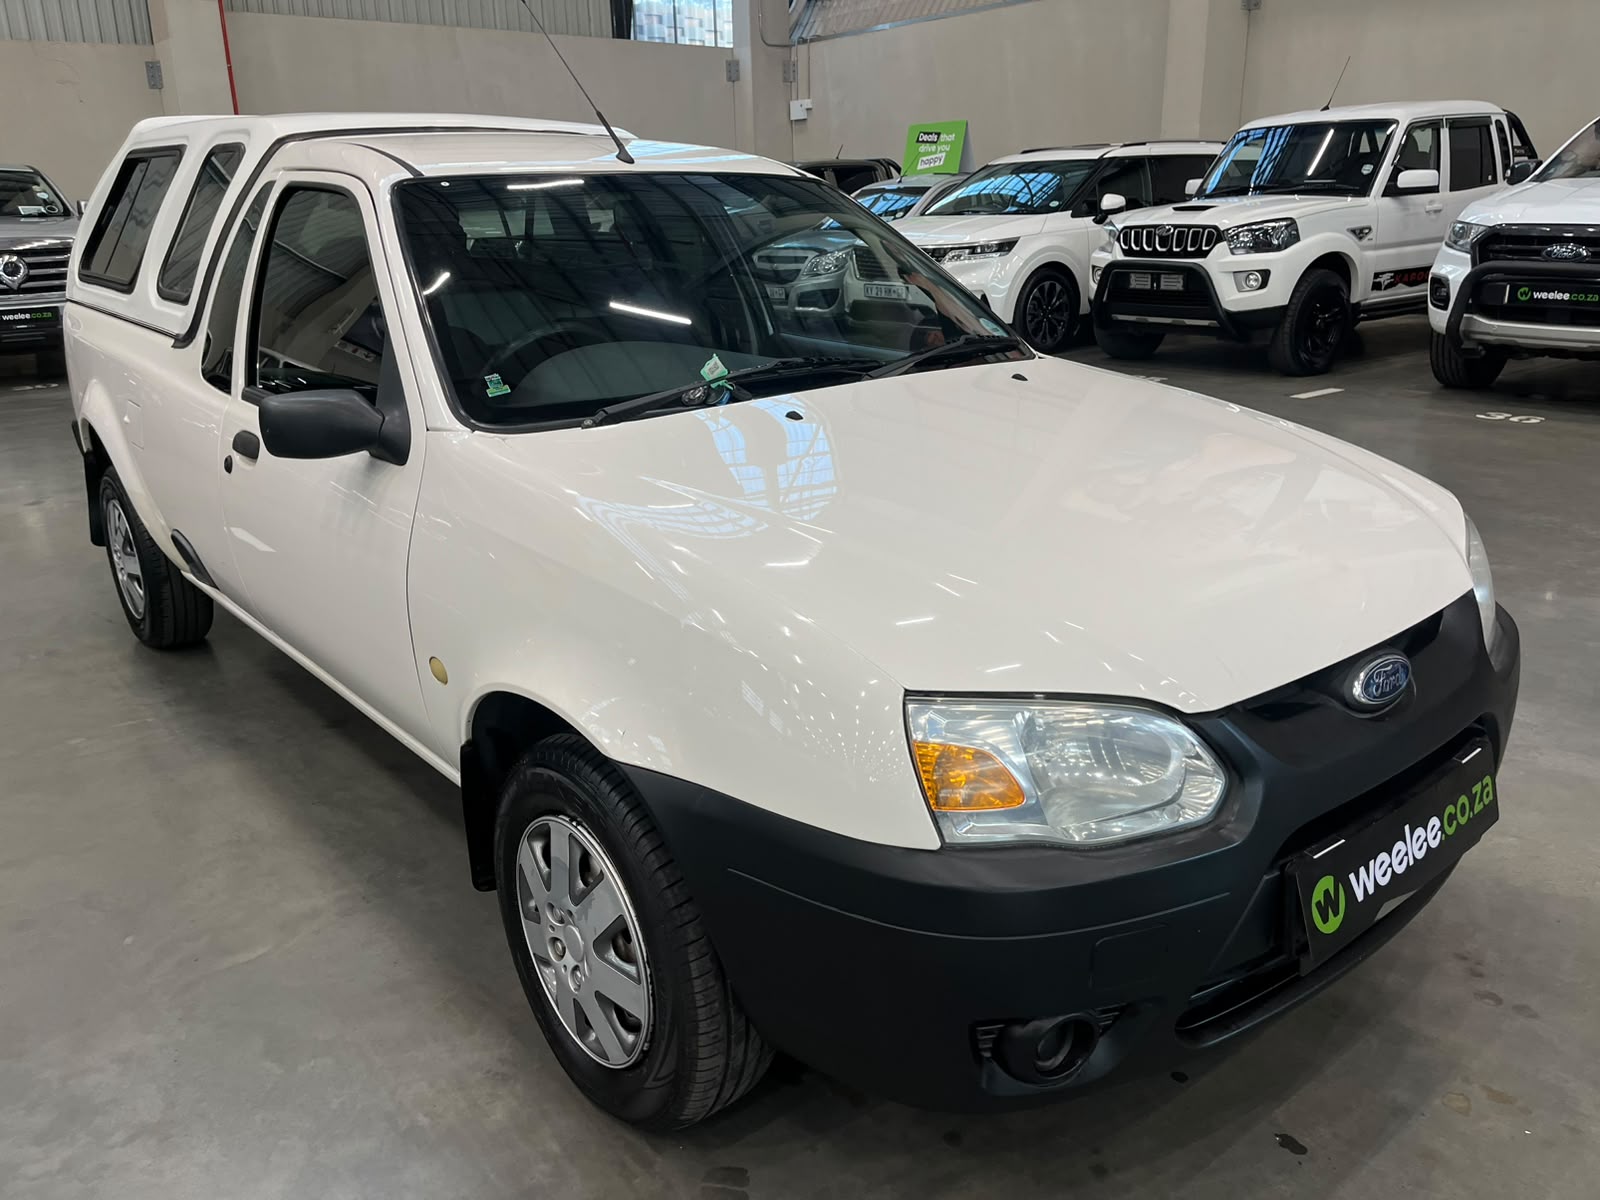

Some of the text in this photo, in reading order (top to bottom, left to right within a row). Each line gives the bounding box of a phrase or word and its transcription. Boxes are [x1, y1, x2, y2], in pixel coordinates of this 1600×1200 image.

[918, 132, 955, 141] Deals that
[918, 144, 951, 154] drive you
[920, 155, 943, 166] happy
[1533, 291, 1599, 302] weelee.co.za
[1475, 411, 1546, 424] 36
[1372, 663, 1404, 697] Ford
[1349, 774, 1494, 903] weelee.co.za
